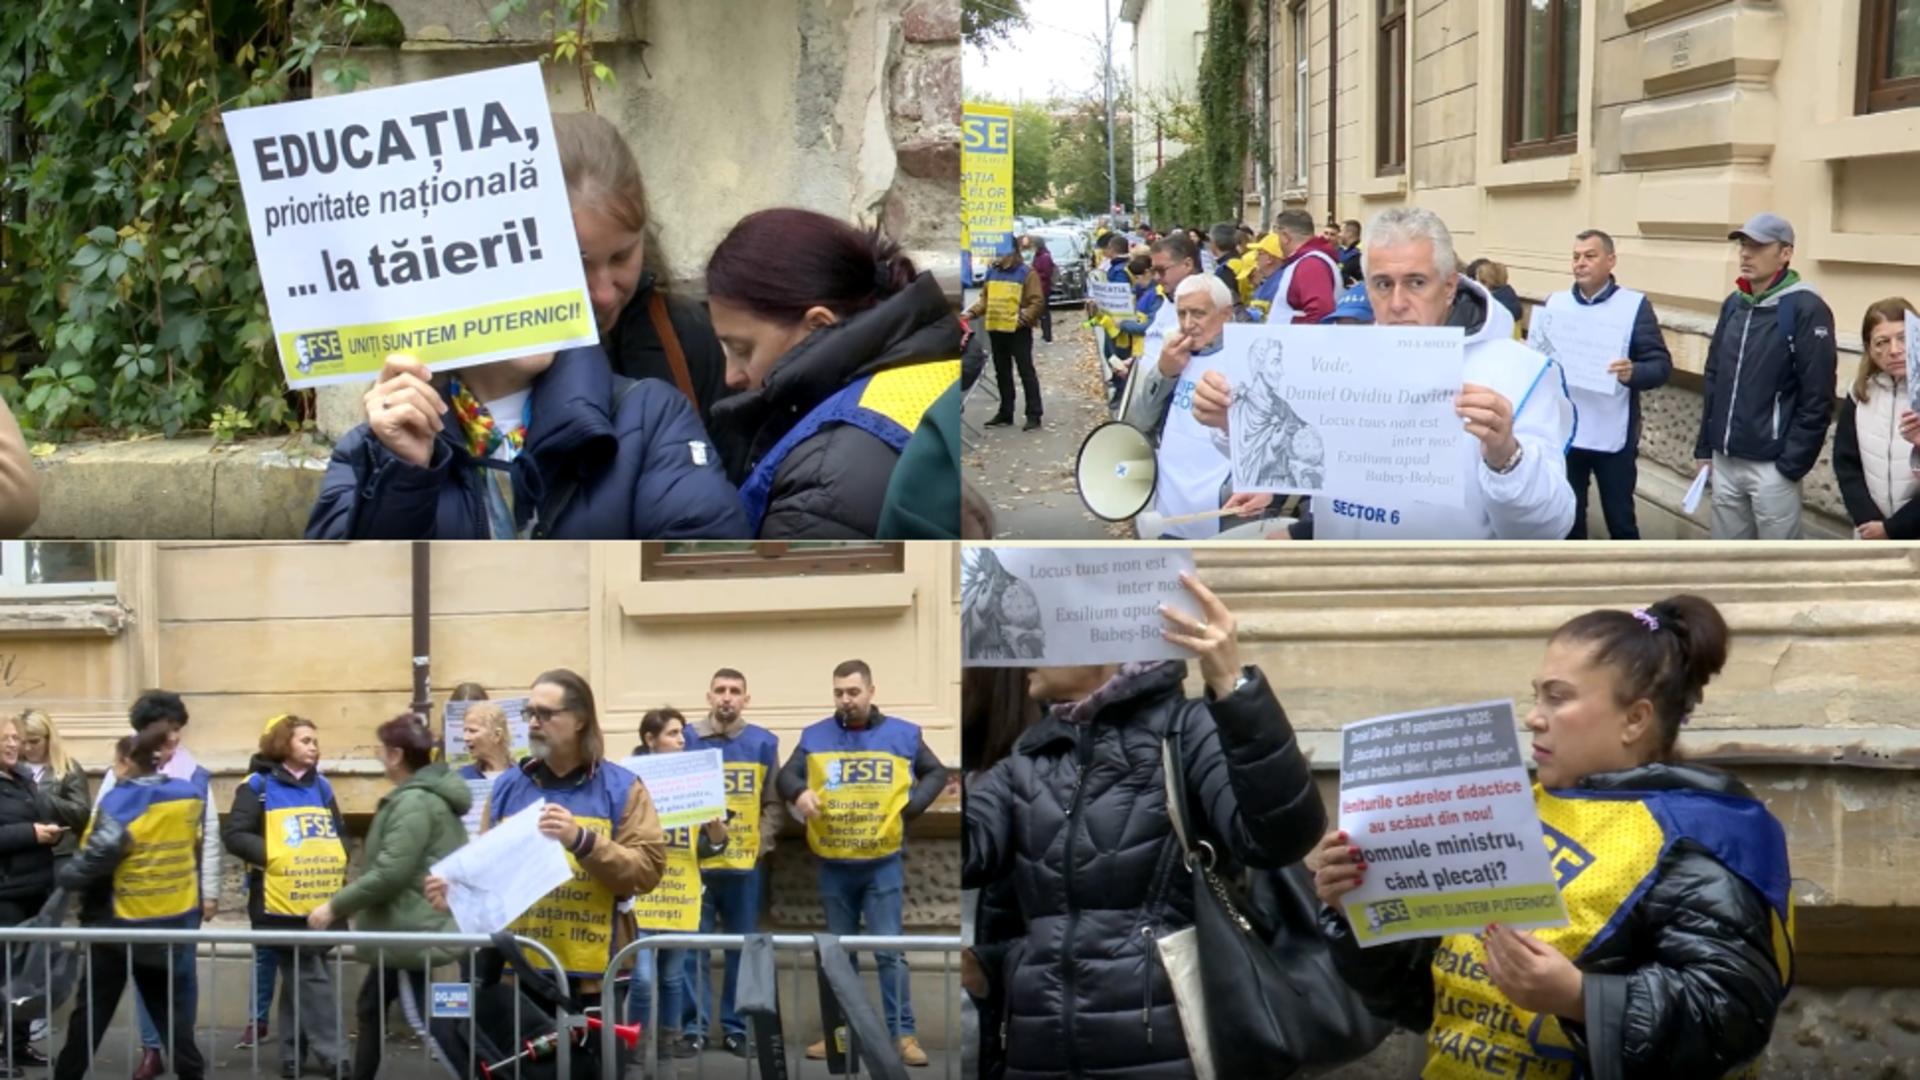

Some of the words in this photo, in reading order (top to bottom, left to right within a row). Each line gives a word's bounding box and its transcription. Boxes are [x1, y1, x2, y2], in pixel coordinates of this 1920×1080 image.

[253, 101, 540, 181] EDUCAȚIA,
[265, 192, 370, 236] prioritate
[379, 158, 538, 217] națională
[368, 217, 543, 287] tăieri!
[348, 336, 381, 358] UNIȚI
[383, 324, 457, 353] SUNTEM
[464, 302, 581, 338] PUTERNICI!
[308, 334, 341, 357] FSE
[1310, 356, 1353, 374] Vade,
[1285, 386, 1336, 402] Daniel
[1339, 387, 1392, 404] Ovidiu
[1319, 414, 1357, 427] Locus
[1359, 416, 1388, 429] tuus
[1391, 418, 1416, 429] non
[1420, 416, 1439, 428] est
[1391, 434, 1424, 447] inter
[1395, 453, 1430, 468] apud
[1333, 499, 1387, 524] SECTOR
[1391, 510, 1400, 525] 6
[1030, 563, 1072, 578] Locus
[1076, 561, 1109, 576] tuus
[1112, 560, 1142, 574] non
[1145, 557, 1167, 570] est
[1117, 580, 1153, 595] inter
[1056, 606, 1118, 623] Exsilium
[843, 761, 891, 782] FSE
[1396, 788, 1452, 808] cadrelor
[1456, 780, 1522, 800] didactice
[828, 800, 880, 810] Sindicat
[300, 815, 338, 838] FSE
[827, 824, 865, 835] Sector
[1369, 821, 1386, 833] au
[1389, 813, 1434, 832] scăzut
[1438, 810, 1459, 826] din
[1463, 806, 1493, 822] nou!
[1436, 831, 1524, 856] ministru,
[1384, 870, 1429, 890] când
[1433, 861, 1507, 891] plecați?
[1376, 902, 1409, 921] FSE
